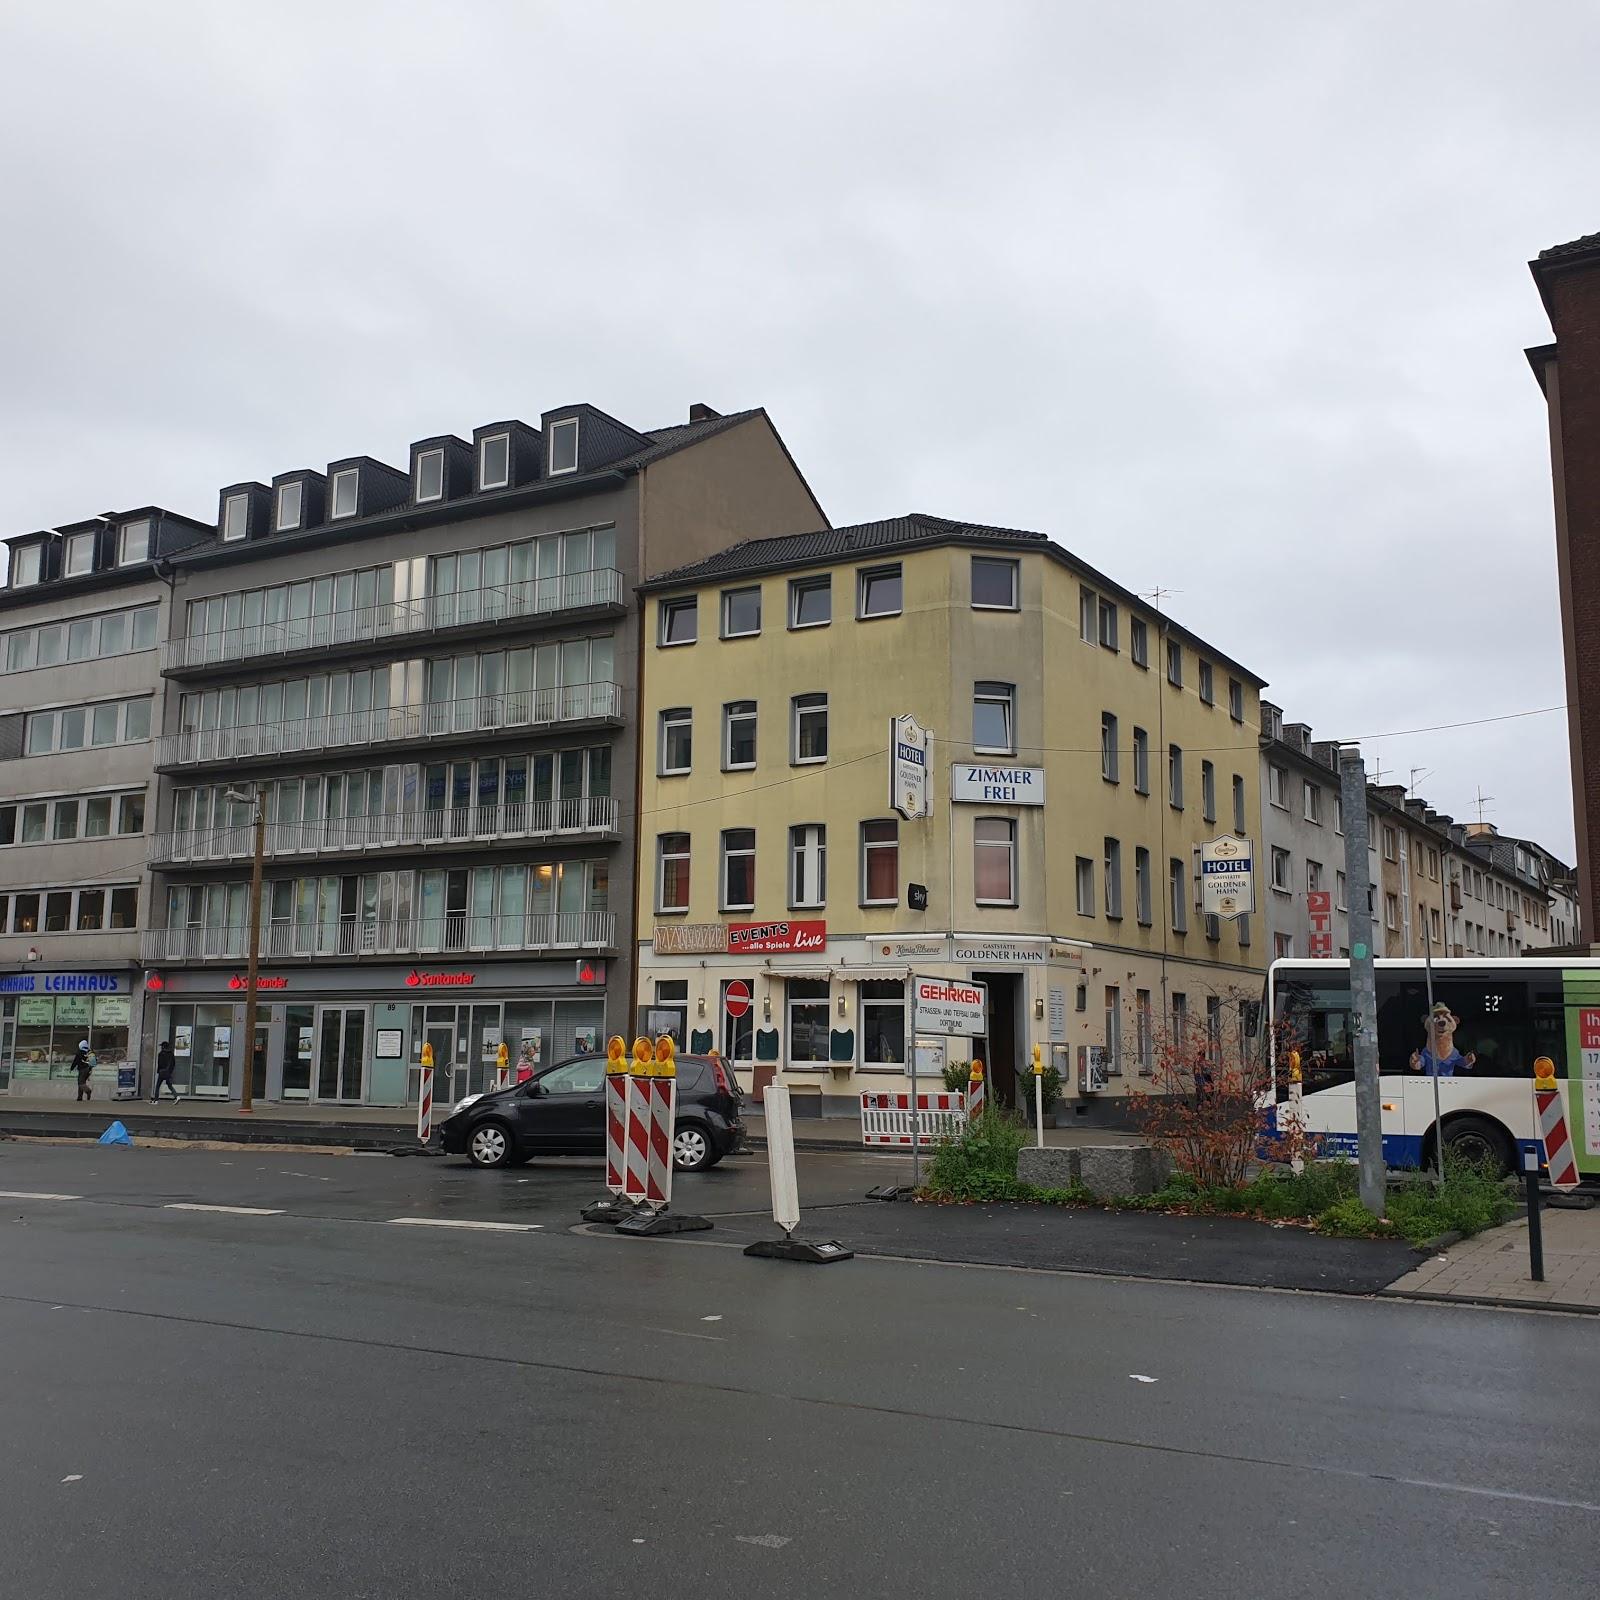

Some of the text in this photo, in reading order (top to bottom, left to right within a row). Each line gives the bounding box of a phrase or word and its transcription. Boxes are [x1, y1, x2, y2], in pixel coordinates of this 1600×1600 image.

[900, 744, 923, 764] HOTEL
[968, 768, 1032, 784] ZIMMER
[984, 785, 1016, 800] FREI
[1207, 861, 1248, 872] HOTEL
[914, 889, 926, 903] sky
[729, 922, 789, 944] EVENTS
[765, 942, 791, 951] Spiele
[793, 930, 824, 948] live
[956, 949, 1010, 960] GOLDENER
[1012, 950, 1043, 960] HAHN
[0, 976, 35, 991] EIHHAUS
[45, 975, 118, 991] LEIHHAUS
[241, 976, 288, 989] Stander
[420, 972, 476, 985] Santander
[920, 984, 981, 1004] GEHRKEN
[387, 1003, 396, 1011] 89
[939, 1019, 963, 1027] DORTMUND
